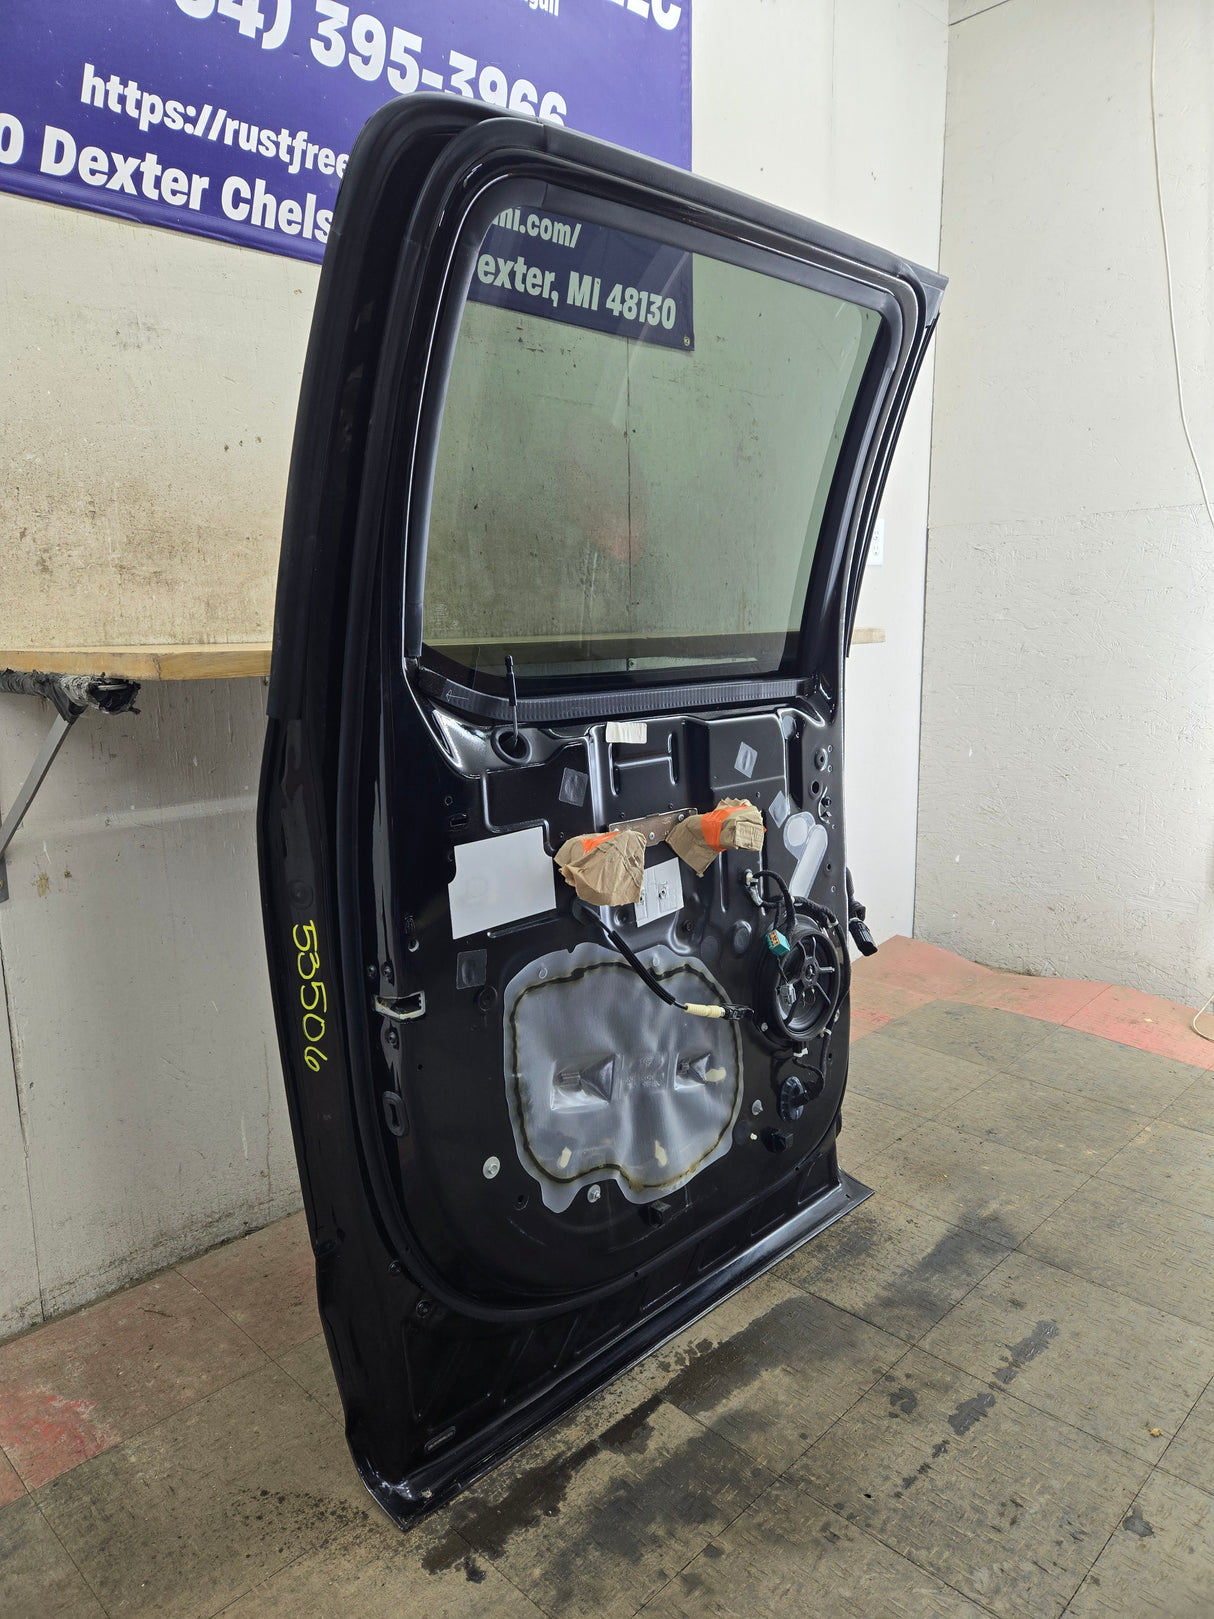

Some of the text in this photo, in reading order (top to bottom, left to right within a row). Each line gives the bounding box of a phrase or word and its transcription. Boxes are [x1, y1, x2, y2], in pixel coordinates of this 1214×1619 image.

[81, 62, 350, 179] https://rustfree
[310, 0, 567, 128] 395-3966
[40, 125, 209, 211] Dexter
[221, 176, 334, 244] Chels
[477, 253, 559, 307] exter,
[566, 270, 602, 311] MI
[605, 283, 677, 330] 48130
[292, 919, 329, 1073] 53506
